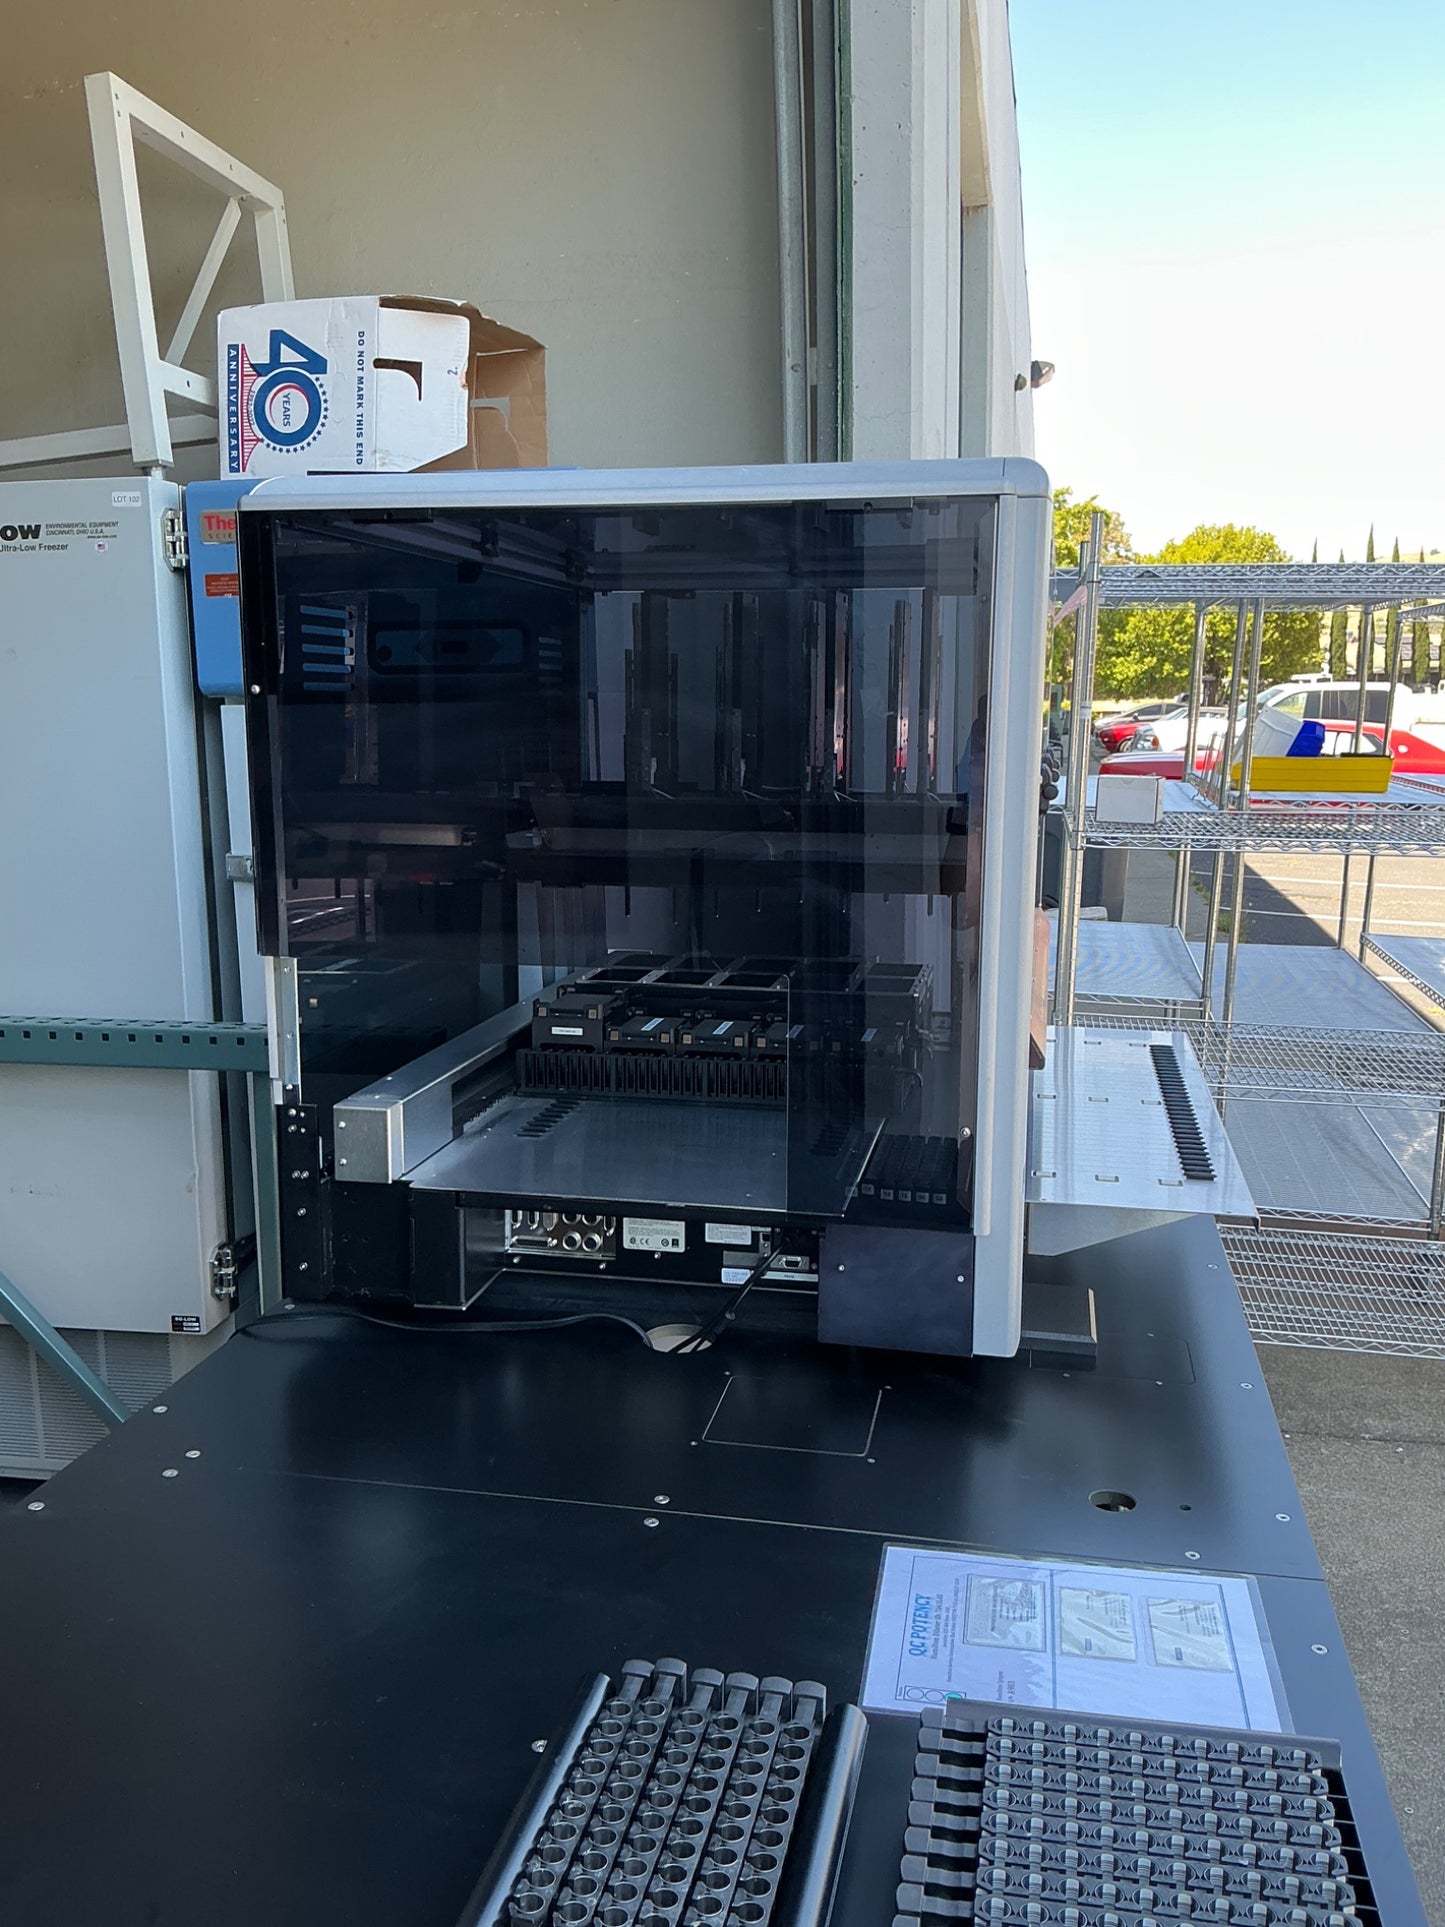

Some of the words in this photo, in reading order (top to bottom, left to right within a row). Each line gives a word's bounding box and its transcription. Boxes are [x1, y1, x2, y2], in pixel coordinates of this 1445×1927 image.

[357, 331, 365, 346] DO
[357, 350, 365, 373] NOT
[249, 329, 328, 447] 40
[356, 376, 364, 409] MARK
[229, 348, 238, 469] ANNIVERSARY
[282, 392, 291, 427] YEARS
[356, 413, 364, 439] THIS
[356, 442, 364, 466] END
[113, 495, 127, 503] LOT
[128, 495, 140, 503] 102
[45, 522, 88, 530] ENVIRONMENTAL
[88, 521, 119, 529] EQUIPMENT
[203, 514, 236, 531] The
[38, 543, 70, 552] Freezer
[910, 1593, 931, 1639] POTENCY
[908, 1640, 927, 1657] QC
